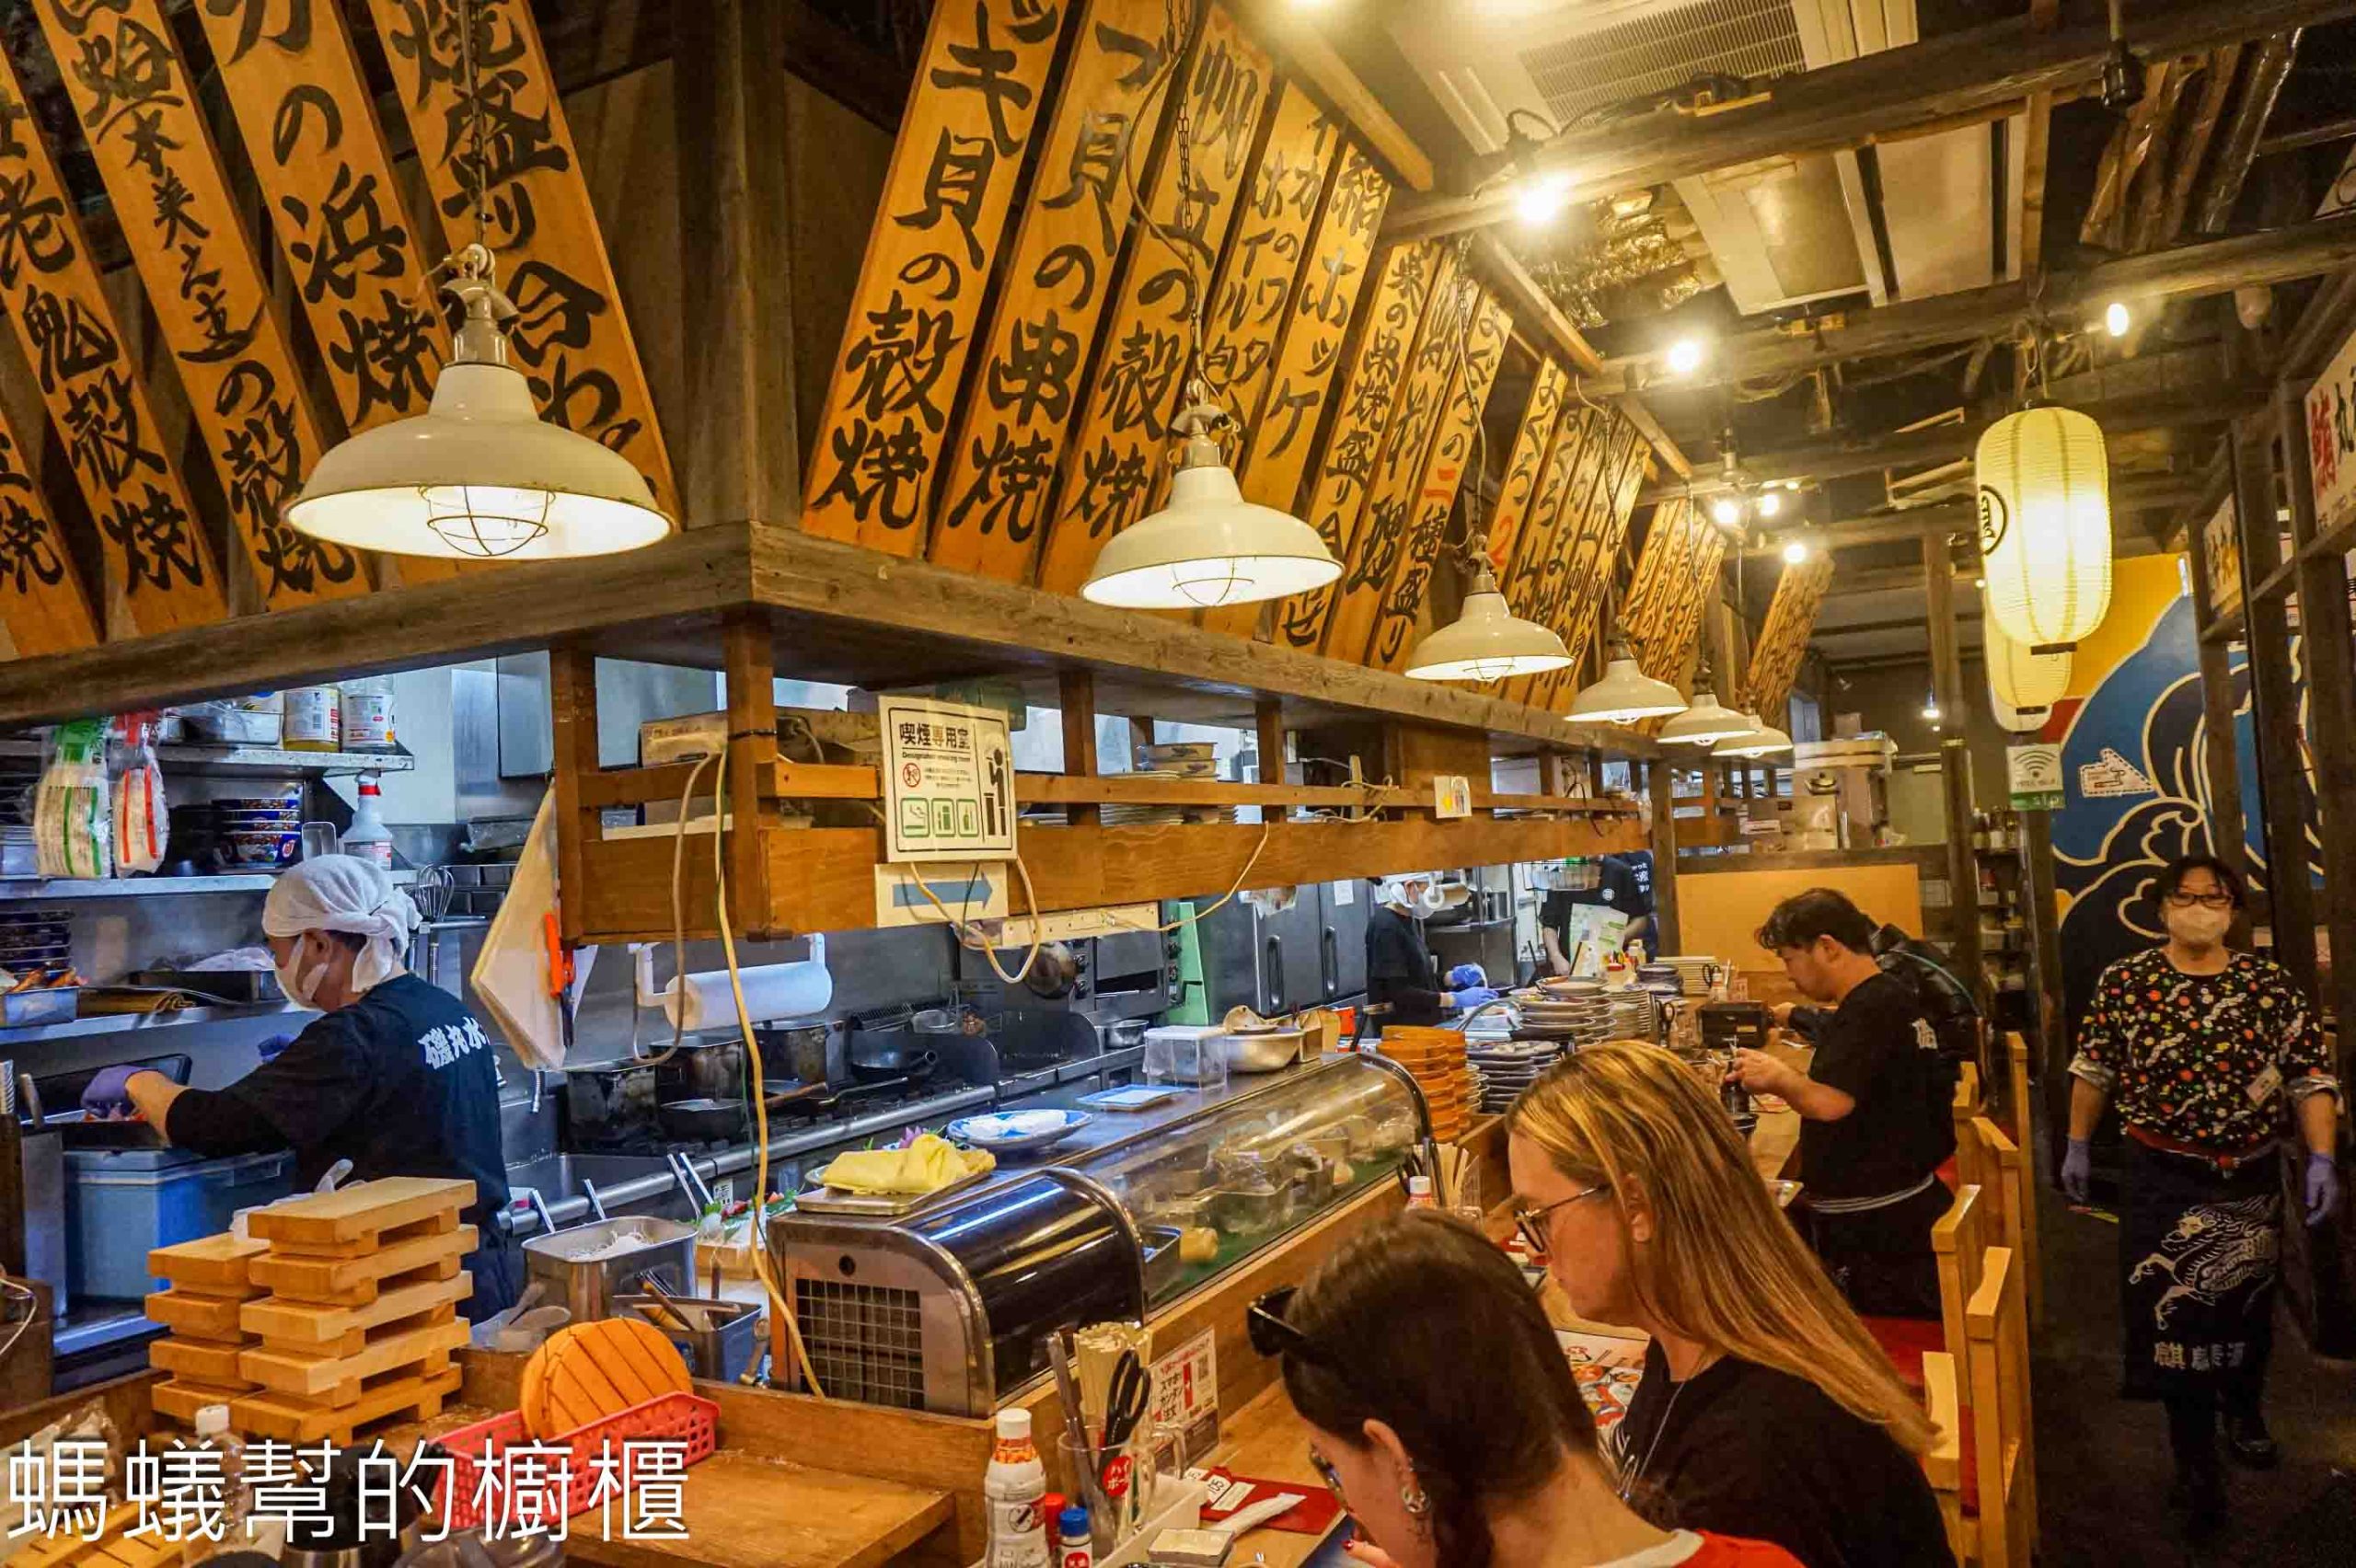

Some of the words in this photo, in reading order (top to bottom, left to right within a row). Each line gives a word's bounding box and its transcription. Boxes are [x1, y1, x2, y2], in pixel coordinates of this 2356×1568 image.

[0, 89, 203, 596] 老鬼殻焼
[390, 0, 656, 497] 焼盛り合わ
[417, 1017, 491, 1069] 磯丸水
